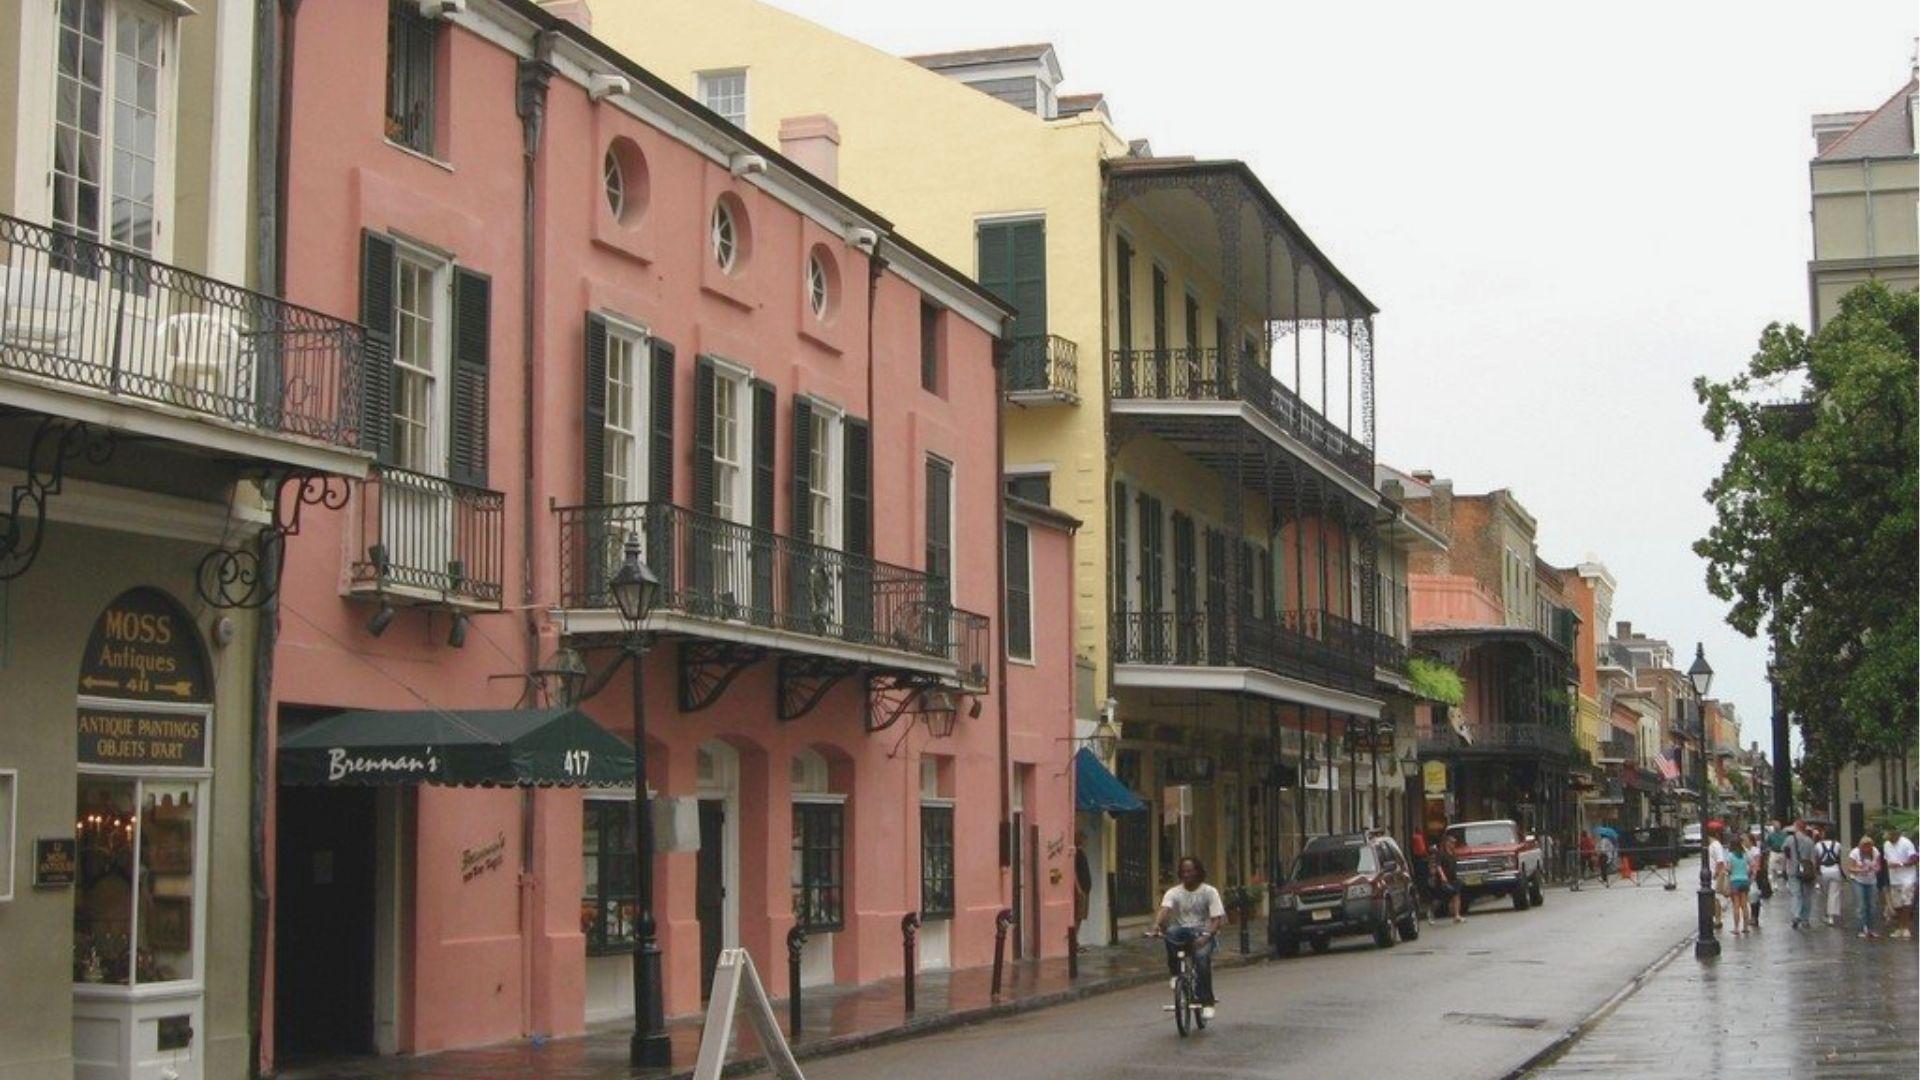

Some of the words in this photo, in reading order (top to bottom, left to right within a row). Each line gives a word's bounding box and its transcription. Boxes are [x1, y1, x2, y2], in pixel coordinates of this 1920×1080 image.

[105, 609, 171, 644] MOSS
[100, 645, 176, 679] Antiques
[125, 677, 149, 692] 411
[79, 716, 133, 738] ANTIQUE
[138, 718, 200, 739] PAINTINGS
[97, 738, 147, 758] OBJETS
[327, 745, 439, 781] Brennan's
[563, 750, 591, 777] 417
